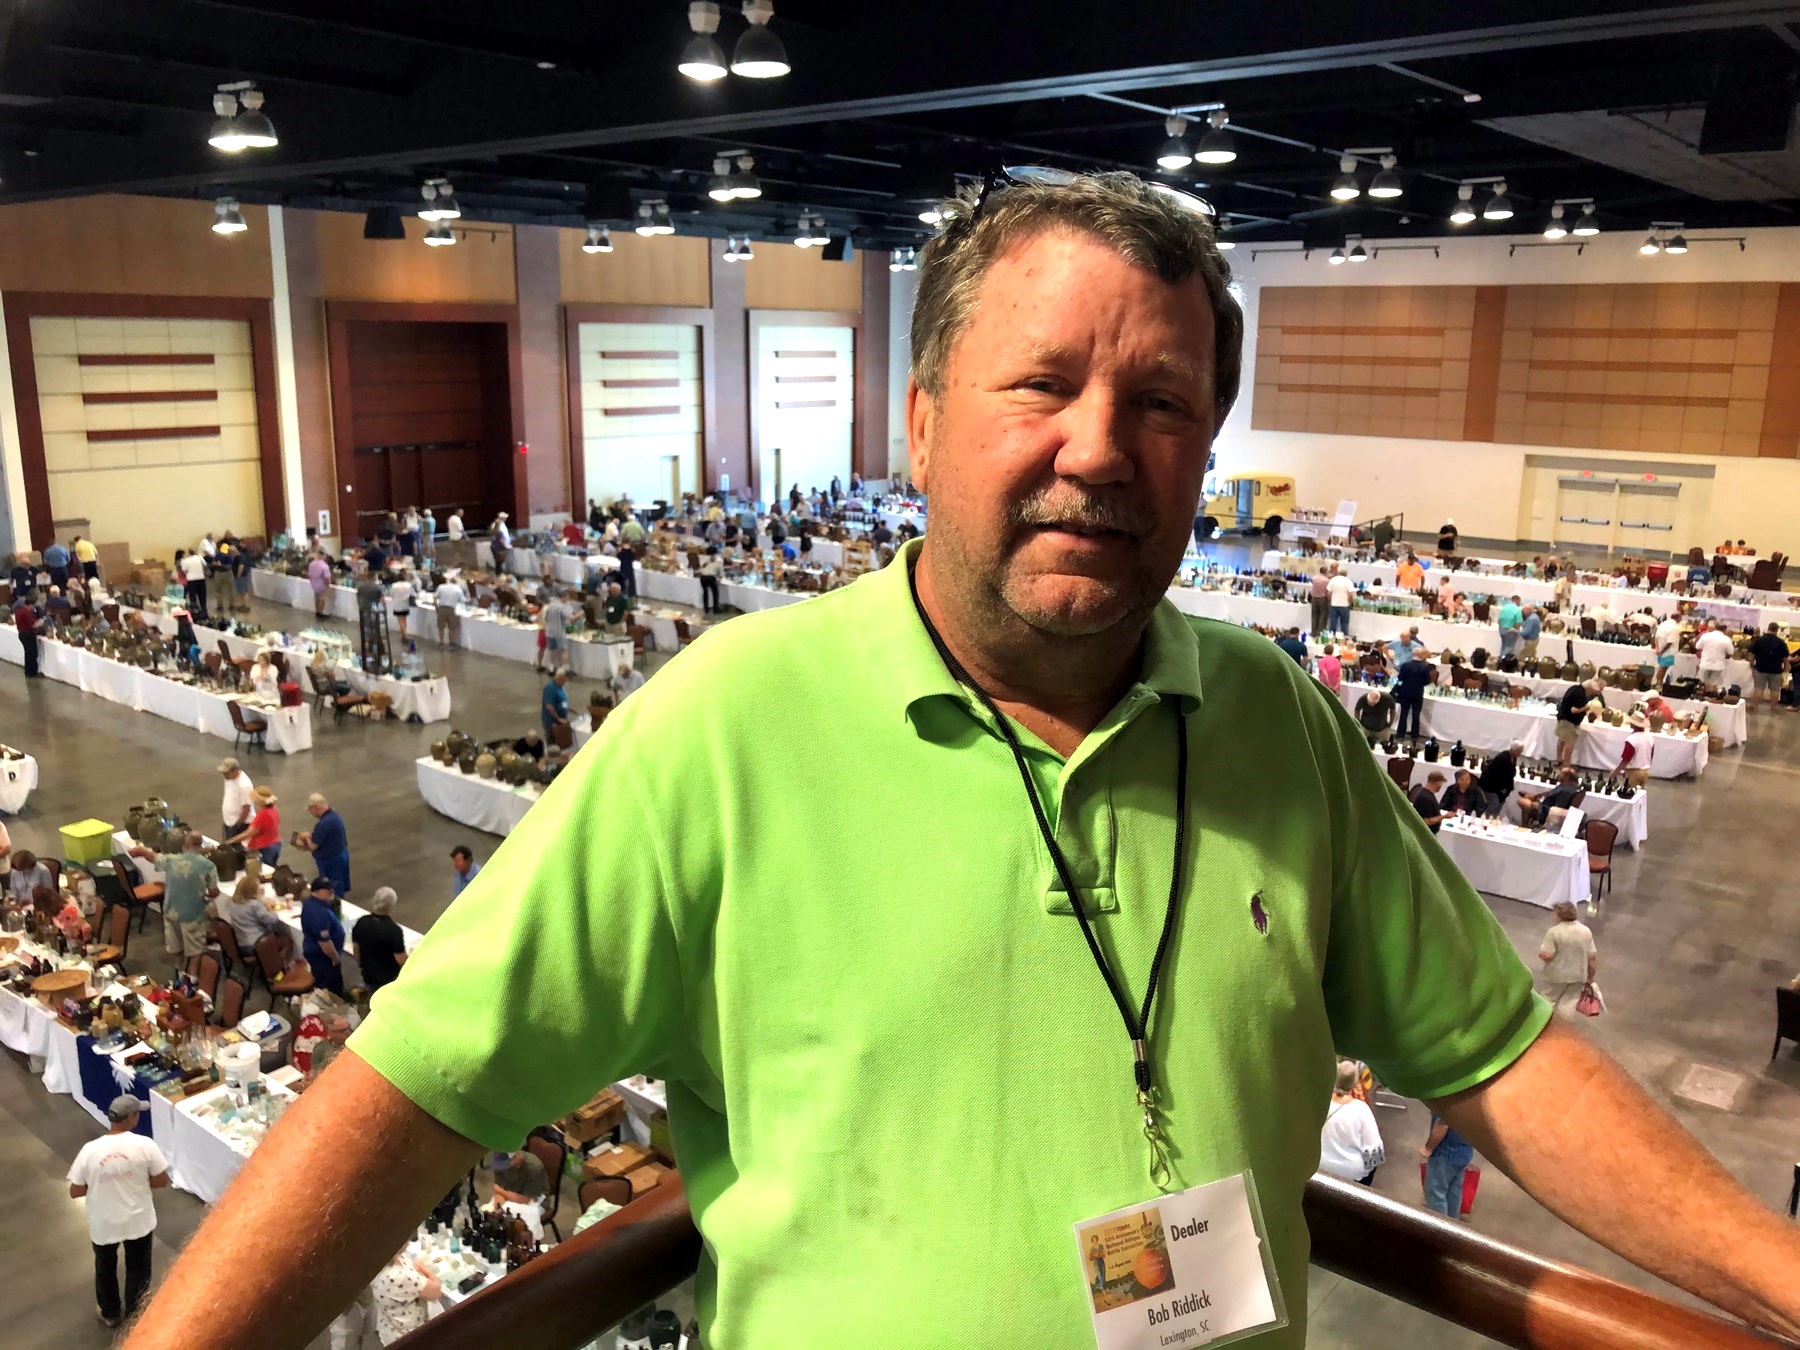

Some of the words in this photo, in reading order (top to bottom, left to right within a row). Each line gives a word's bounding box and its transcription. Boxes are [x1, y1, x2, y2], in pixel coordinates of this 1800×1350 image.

[8, 771, 16, 782] D
[1170, 1217, 1209, 1242] Dealer
[1147, 1303, 1170, 1326] Bob
[1171, 1289, 1212, 1318] Riddick
[1159, 1327, 1199, 1347] Lexington,
[1199, 1319, 1211, 1333] SC
